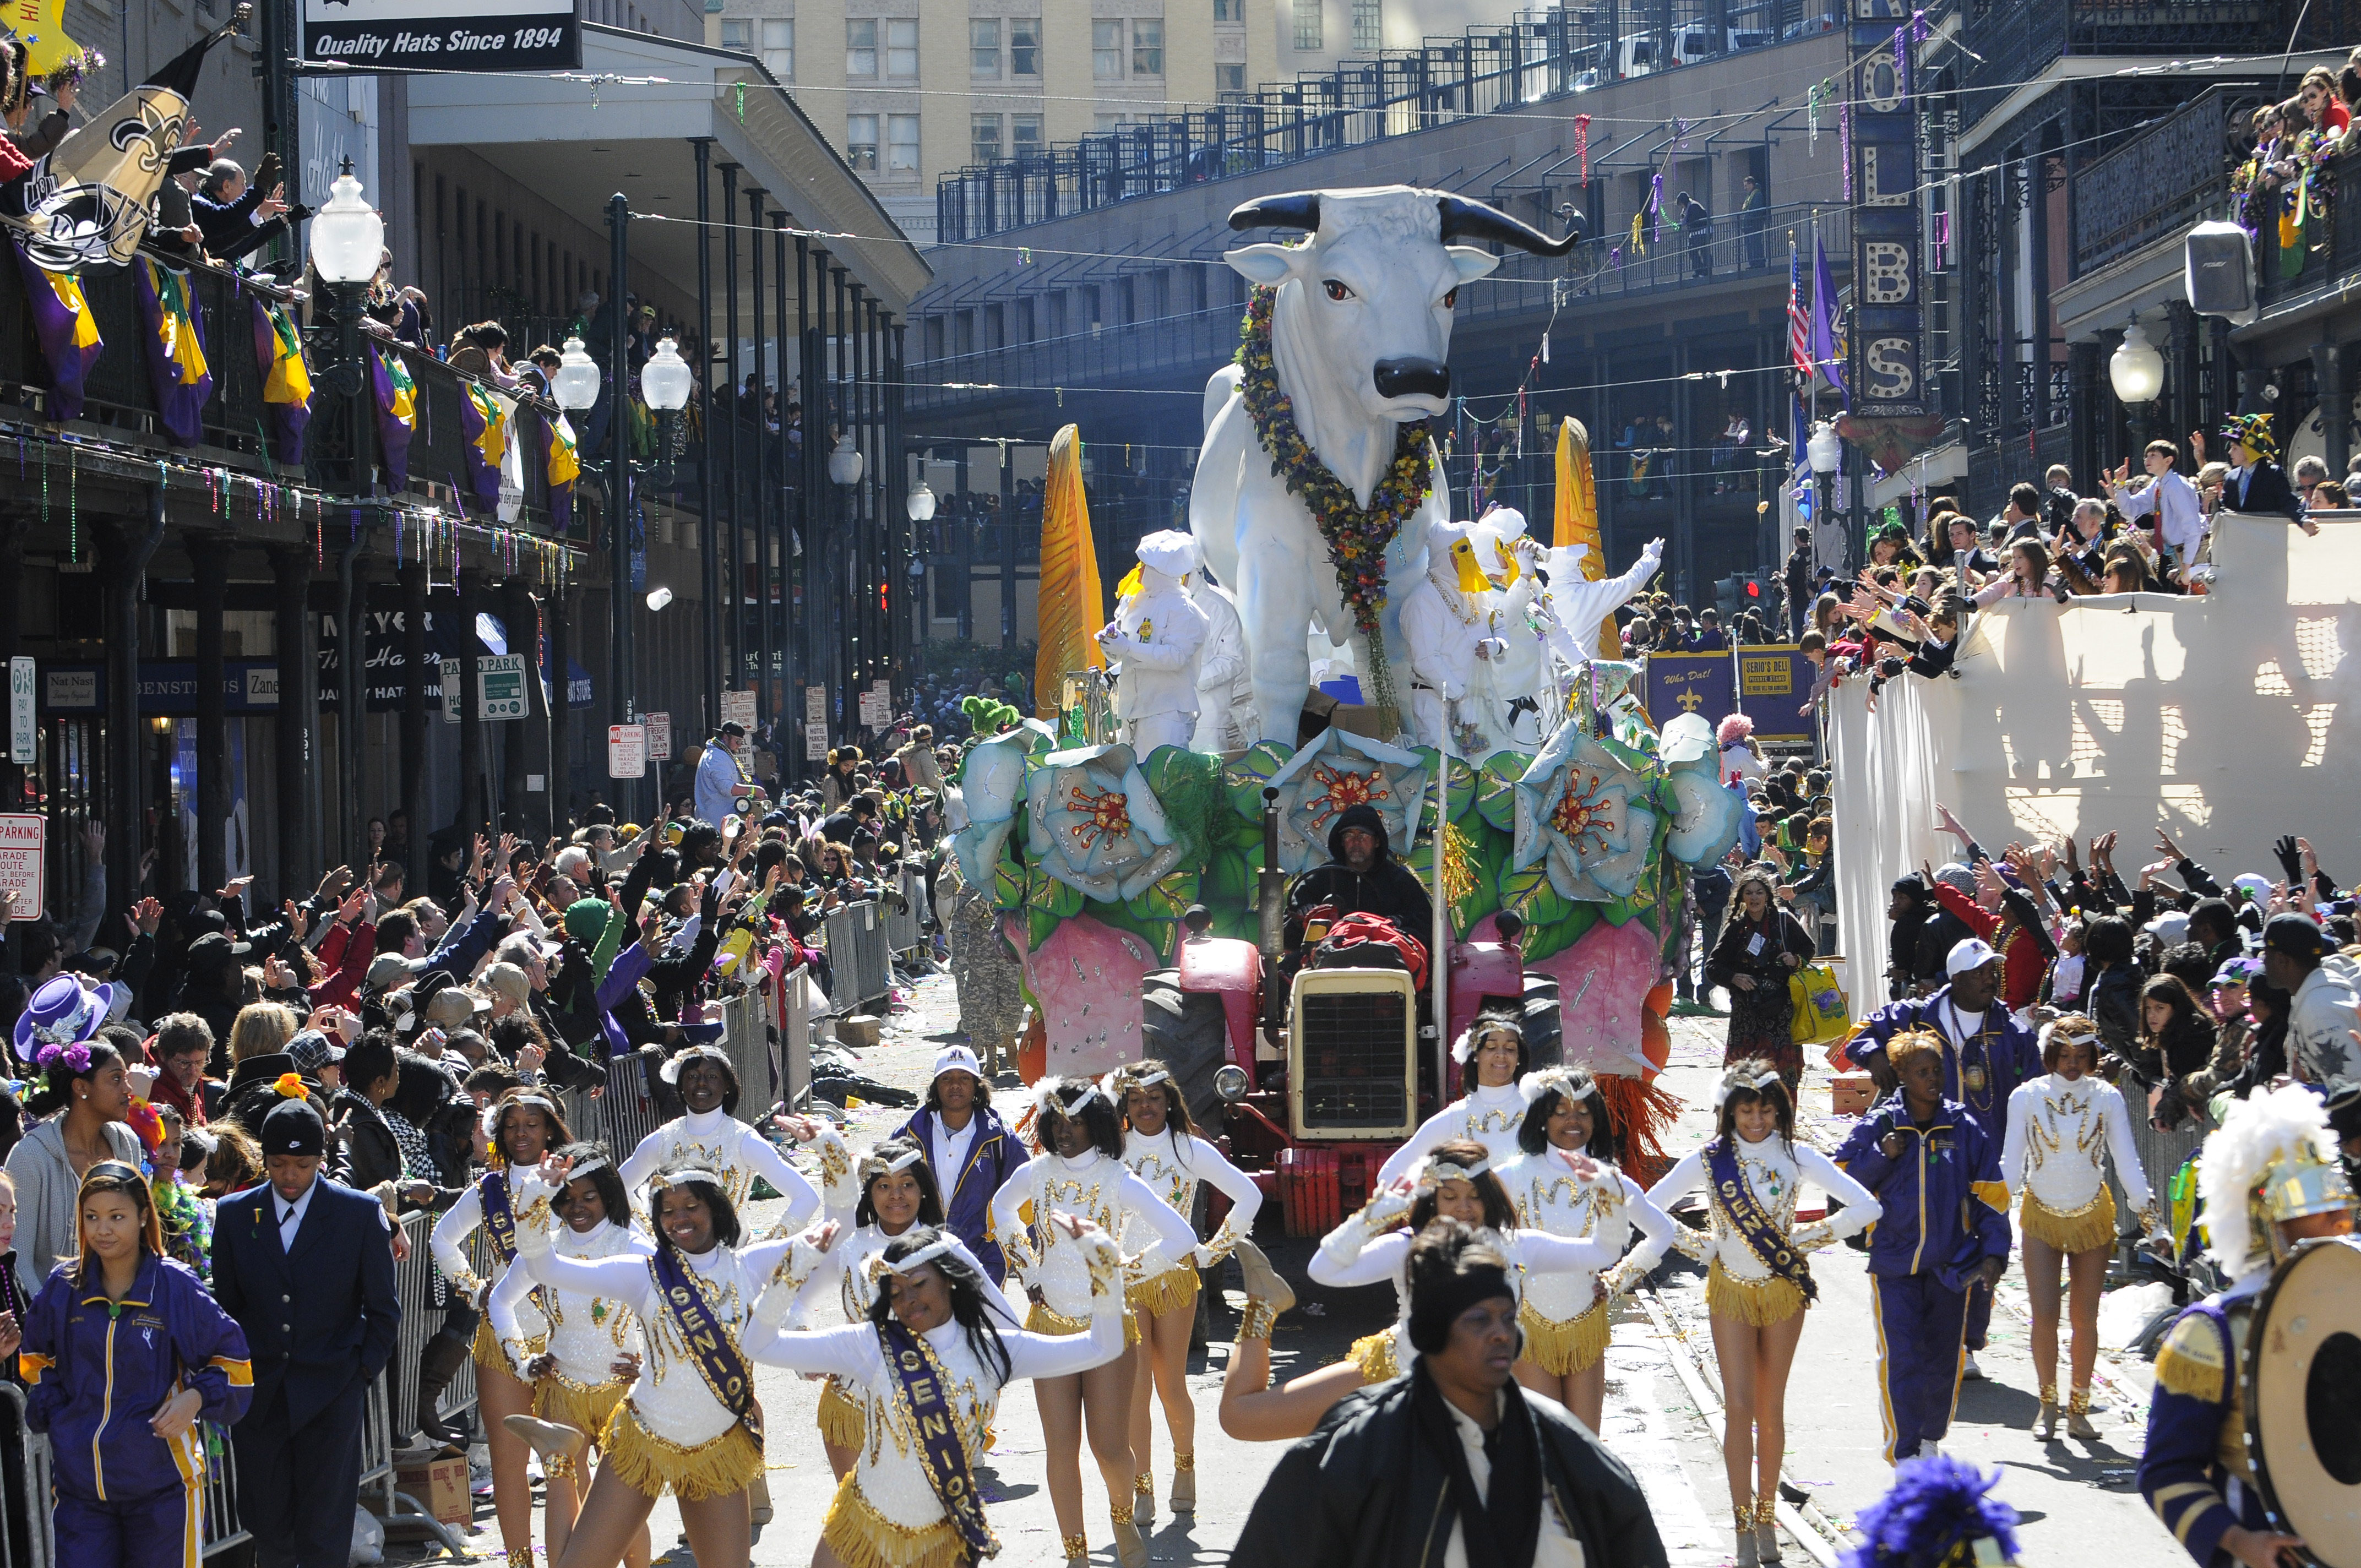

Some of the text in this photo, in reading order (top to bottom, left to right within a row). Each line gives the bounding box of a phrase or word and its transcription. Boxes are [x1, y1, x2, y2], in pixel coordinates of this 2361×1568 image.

[20, 0, 40, 22] HI
[315, 28, 562, 58] Quality Hats Since 1894
[488, 657, 520, 670] PARK
[1746, 661, 1788, 673] SERIO'S DELI
[51, 677, 94, 686] Nat Nast
[1664, 668, 1712, 685] Who Dat!
[18, 699, 28, 711] PAY
[20, 716, 28, 728] TO
[646, 716, 653, 725] NO
[611, 730, 620, 740] NO
[649, 726, 667, 734] FREIGHT
[17, 732, 31, 744] PARK
[900, 1350, 976, 1521] SENIOR
